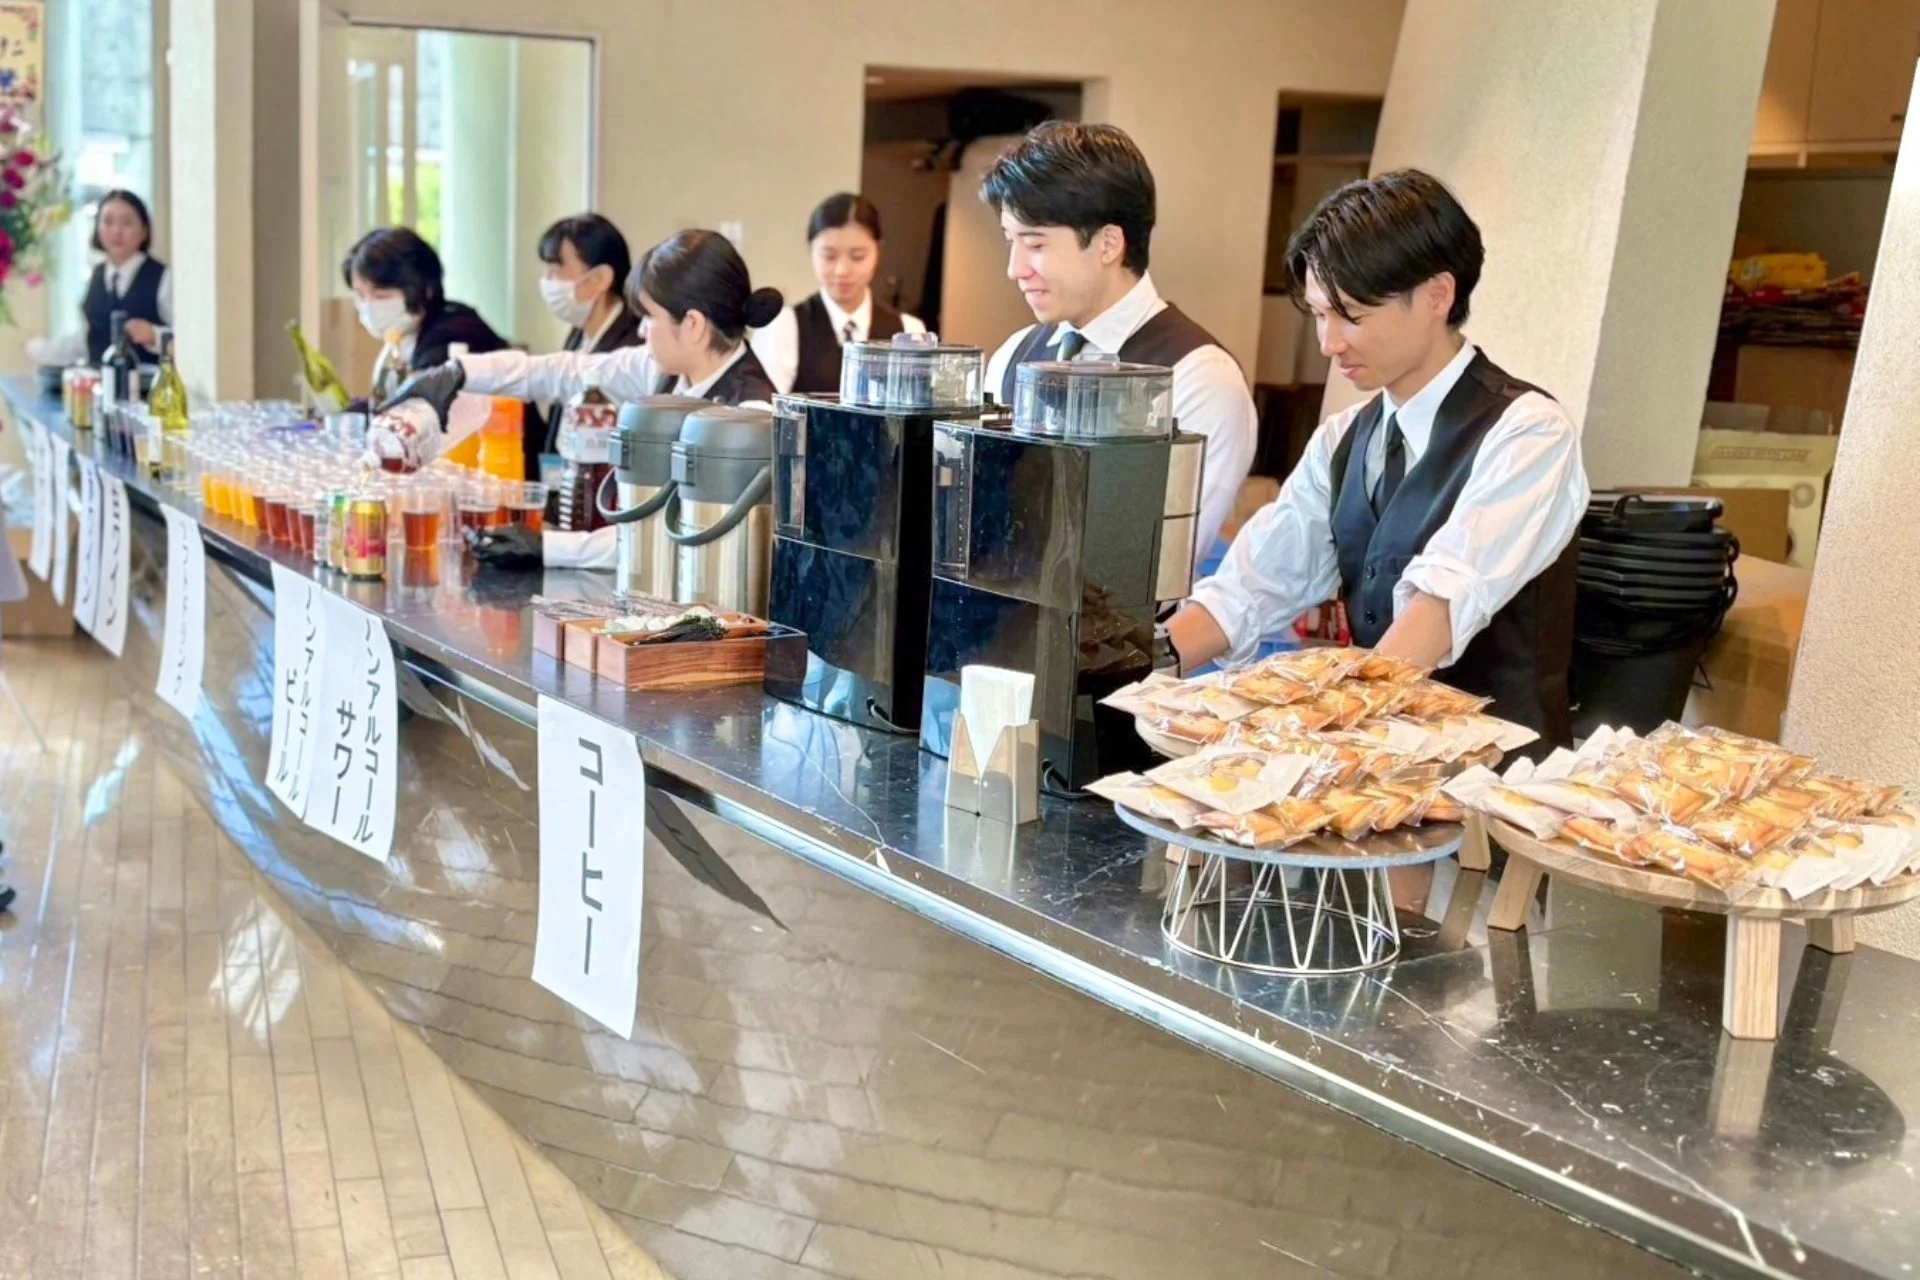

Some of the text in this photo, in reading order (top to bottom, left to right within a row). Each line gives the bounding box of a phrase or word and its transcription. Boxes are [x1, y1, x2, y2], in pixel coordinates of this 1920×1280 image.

[276, 668, 298, 781] ビール
[288, 587, 315, 800] ノンアルコール
[332, 699, 357, 825] サワー
[354, 619, 381, 844] ノンアルコール
[578, 737, 604, 975] コーヒー
